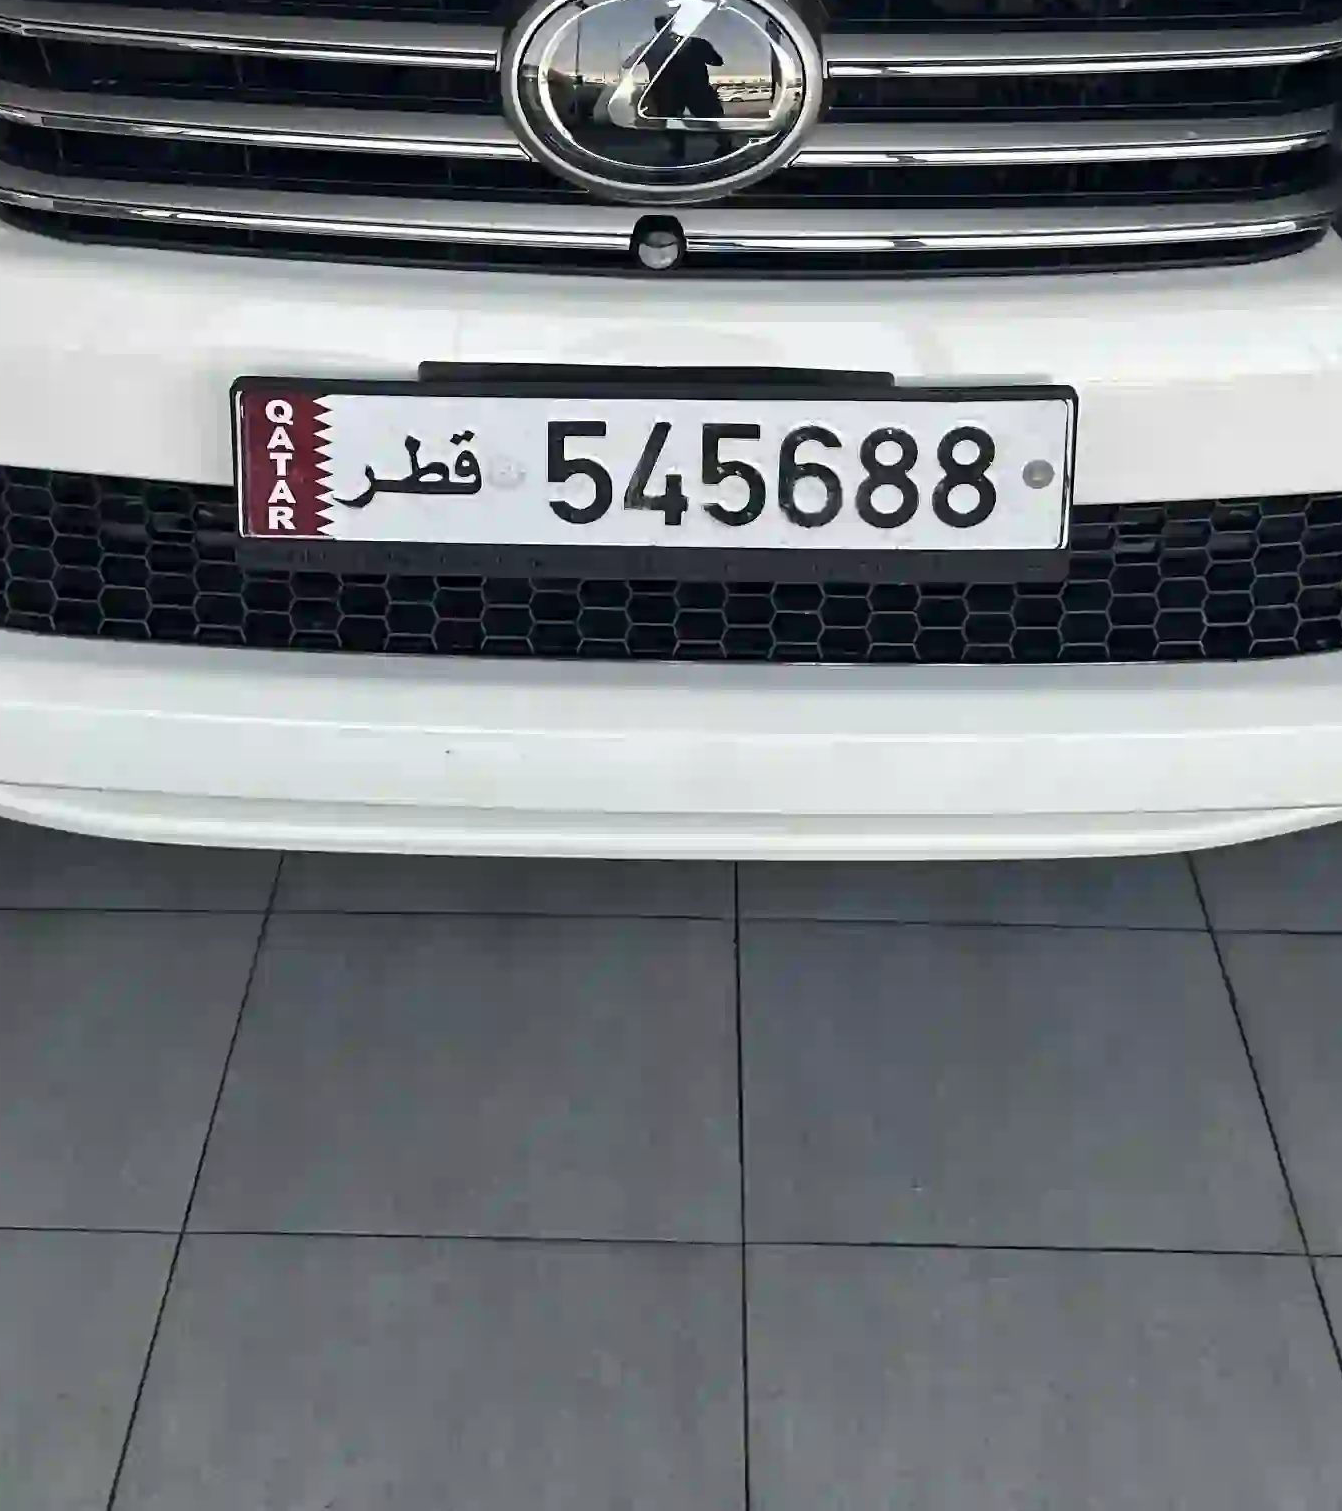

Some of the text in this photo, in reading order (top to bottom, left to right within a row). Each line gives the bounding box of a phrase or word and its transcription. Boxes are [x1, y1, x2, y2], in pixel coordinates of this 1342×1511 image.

[264, 399, 297, 530] QATAR
[333, 429, 483, 509] قطر
[547, 420, 997, 529] 545688
